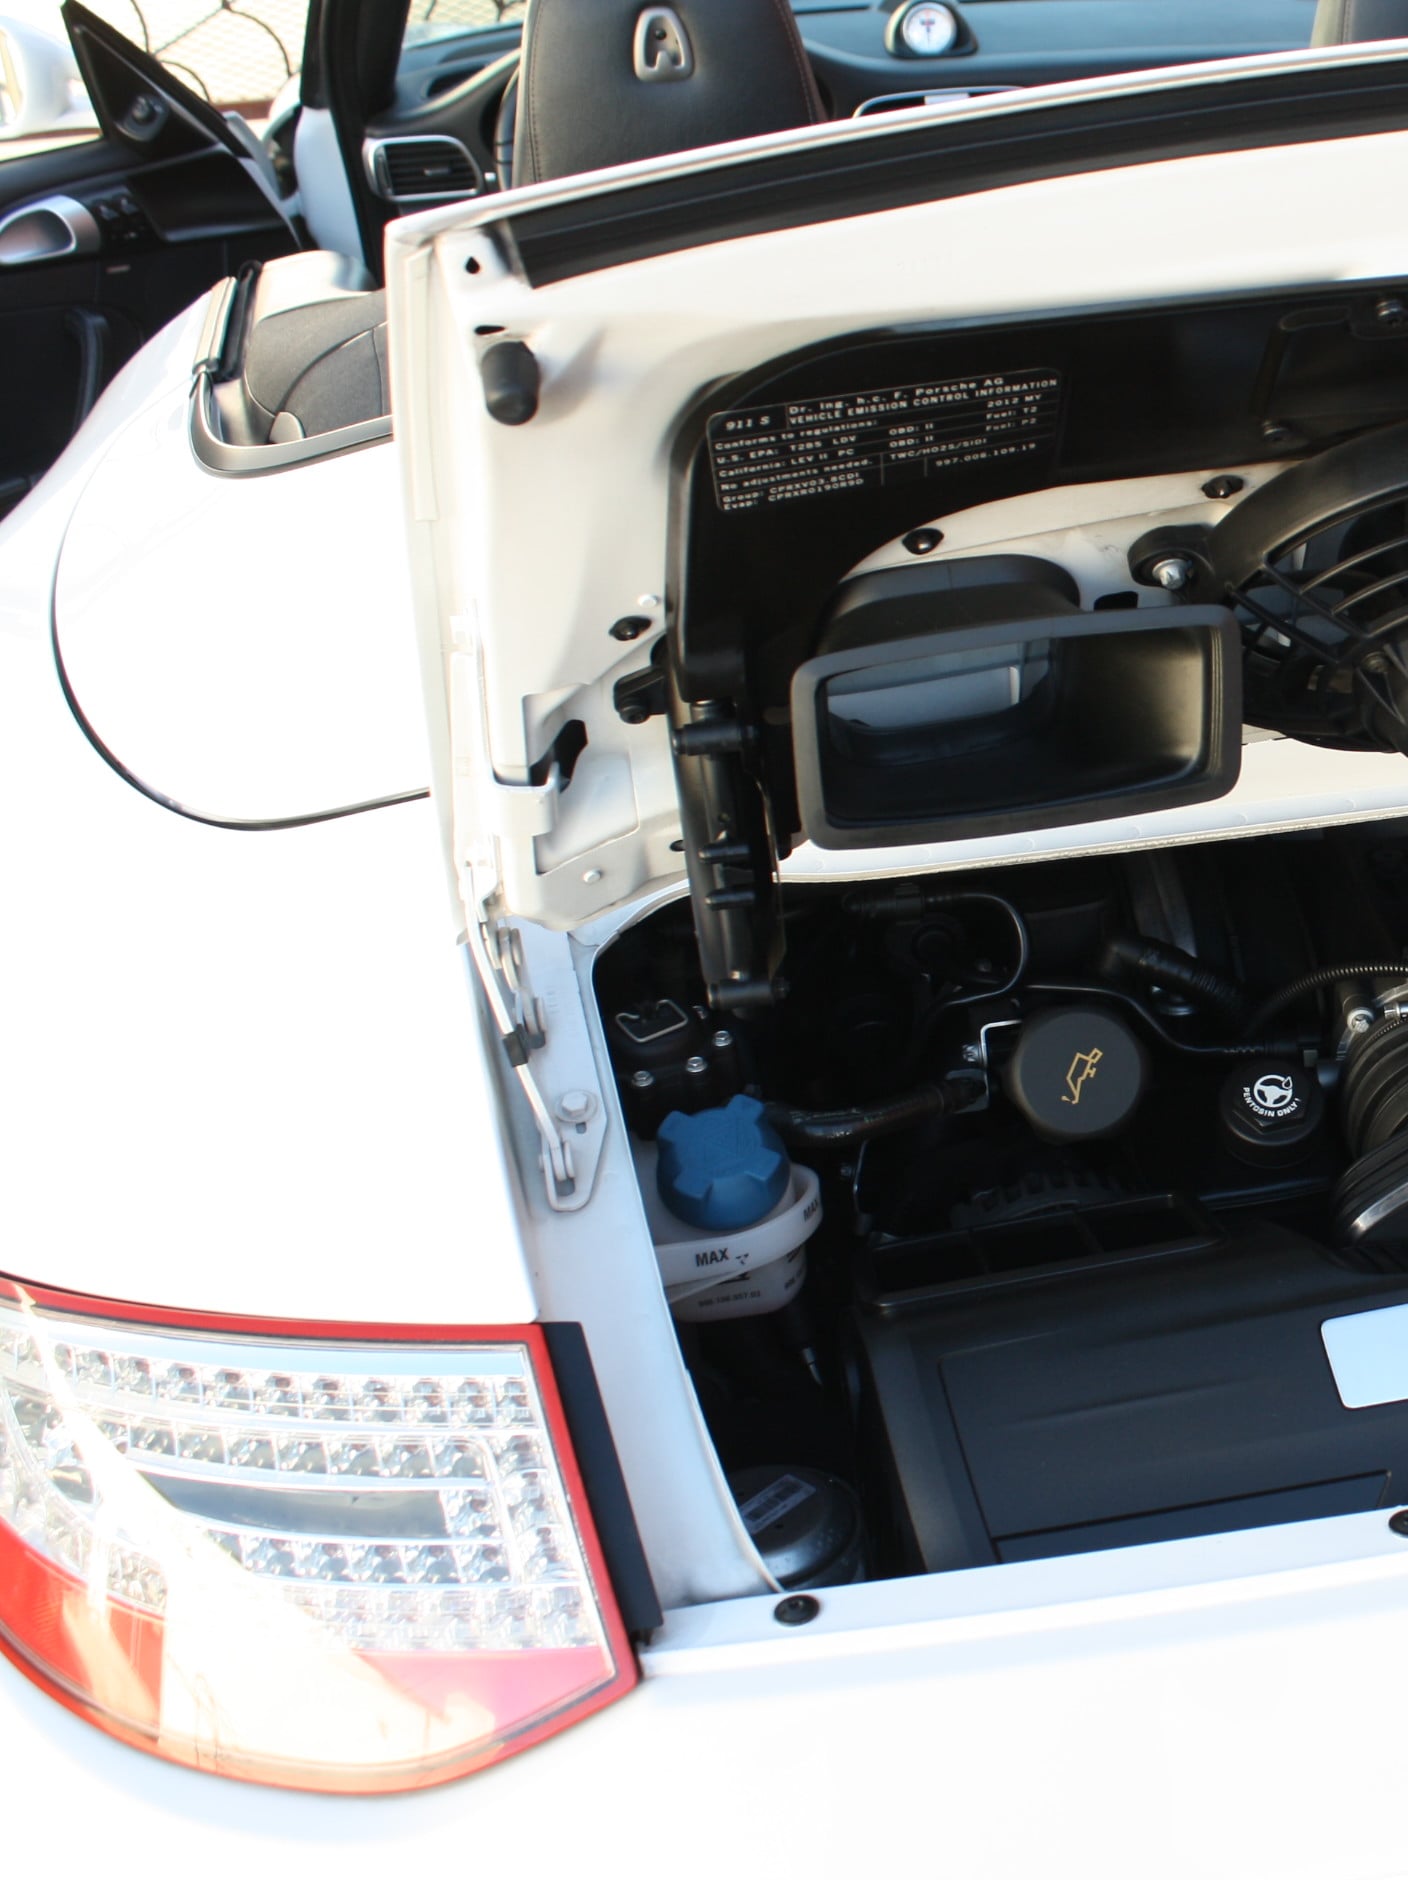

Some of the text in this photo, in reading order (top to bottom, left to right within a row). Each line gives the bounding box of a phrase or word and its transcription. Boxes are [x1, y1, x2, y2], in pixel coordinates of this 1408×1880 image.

[789, 405, 813, 415] Dr.
[819, 400, 850, 411] Ing.
[894, 390, 909, 400] F.
[915, 381, 978, 396] Porsche
[983, 377, 1005, 387] AG
[789, 378, 1058, 425] VEHICLE EMISSION CONTROL INFORMATION
[714, 393, 1043, 450] Conforms to regulations: 2012 MY
[725, 415, 771, 431] 911 S
[716, 453, 745, 464] U.S.
[749, 448, 780, 459] EPA:
[718, 460, 787, 478] California:
[790, 454, 815, 466] LEV
[837, 447, 855, 457] PC
[720, 482, 739, 491] No
[742, 467, 819, 488] adjustments
[1242, 1087, 1275, 1117] PENTOSIN
[695, 1247, 730, 1267] MAX
